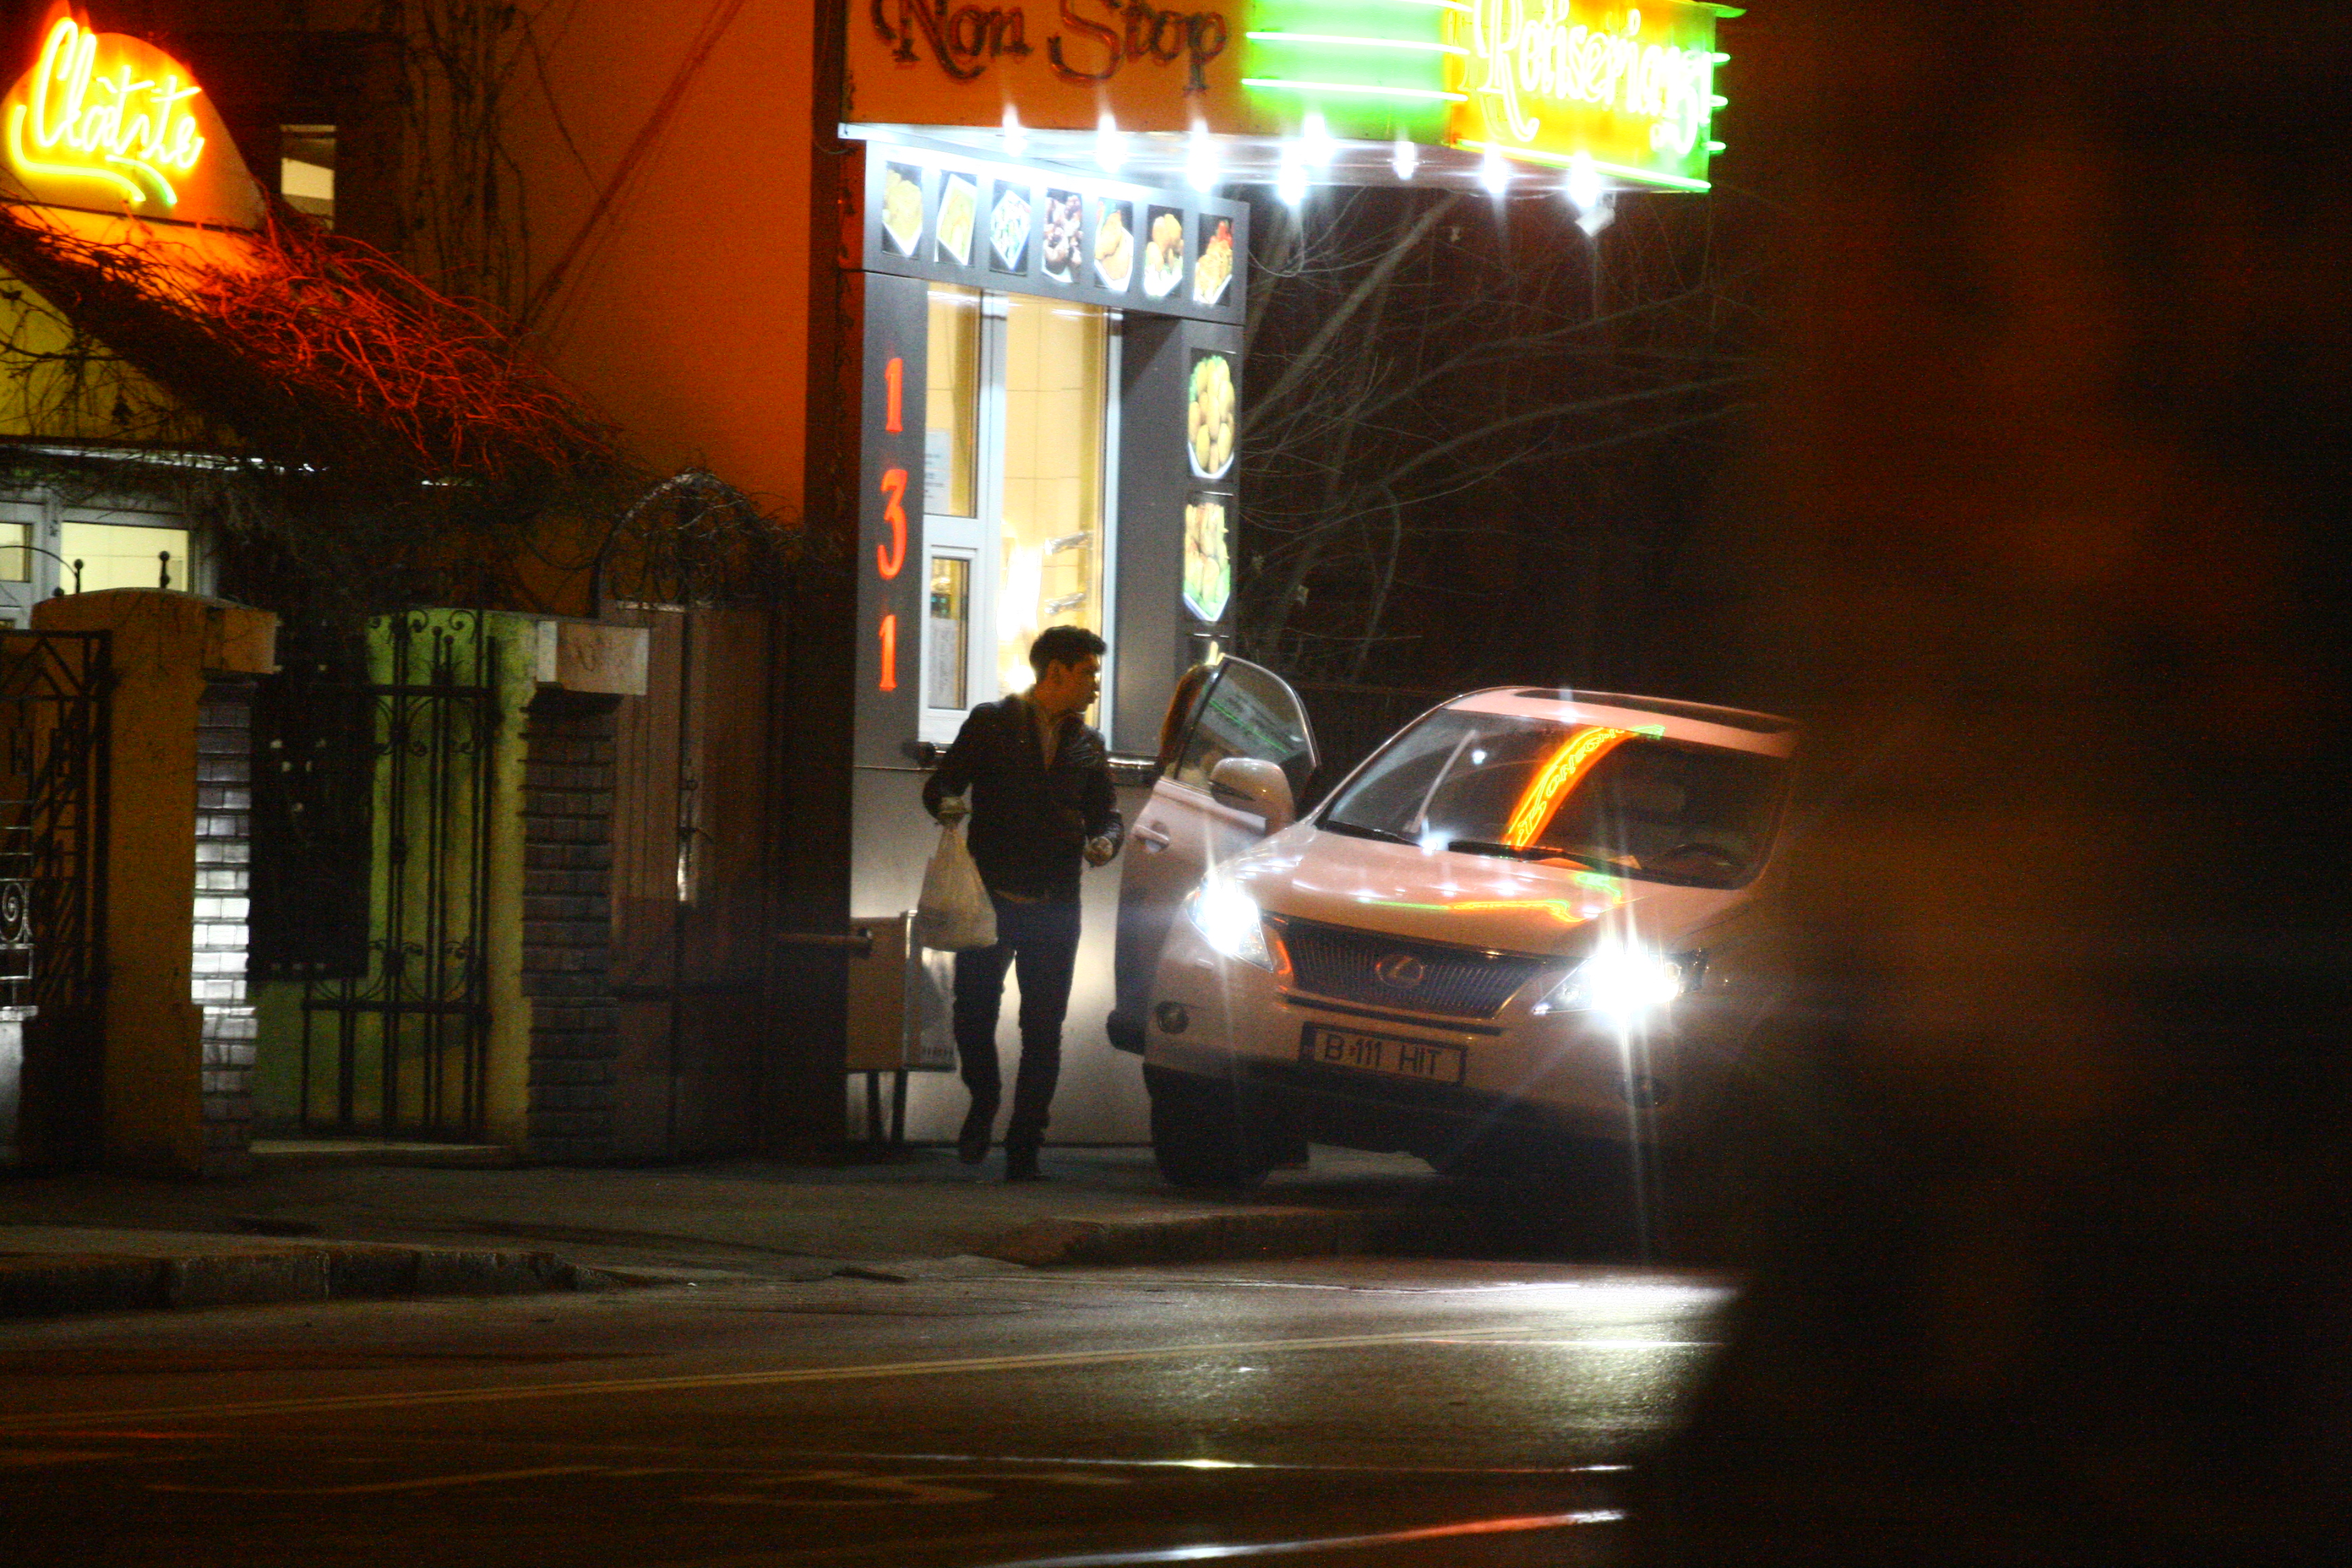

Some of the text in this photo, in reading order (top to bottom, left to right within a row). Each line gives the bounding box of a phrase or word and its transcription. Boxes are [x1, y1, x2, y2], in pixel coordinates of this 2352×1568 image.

[871, 0, 1226, 95] Non Stop
[1324, 1033, 1345, 1061] B
[1399, 1045, 1441, 1075] HIT
